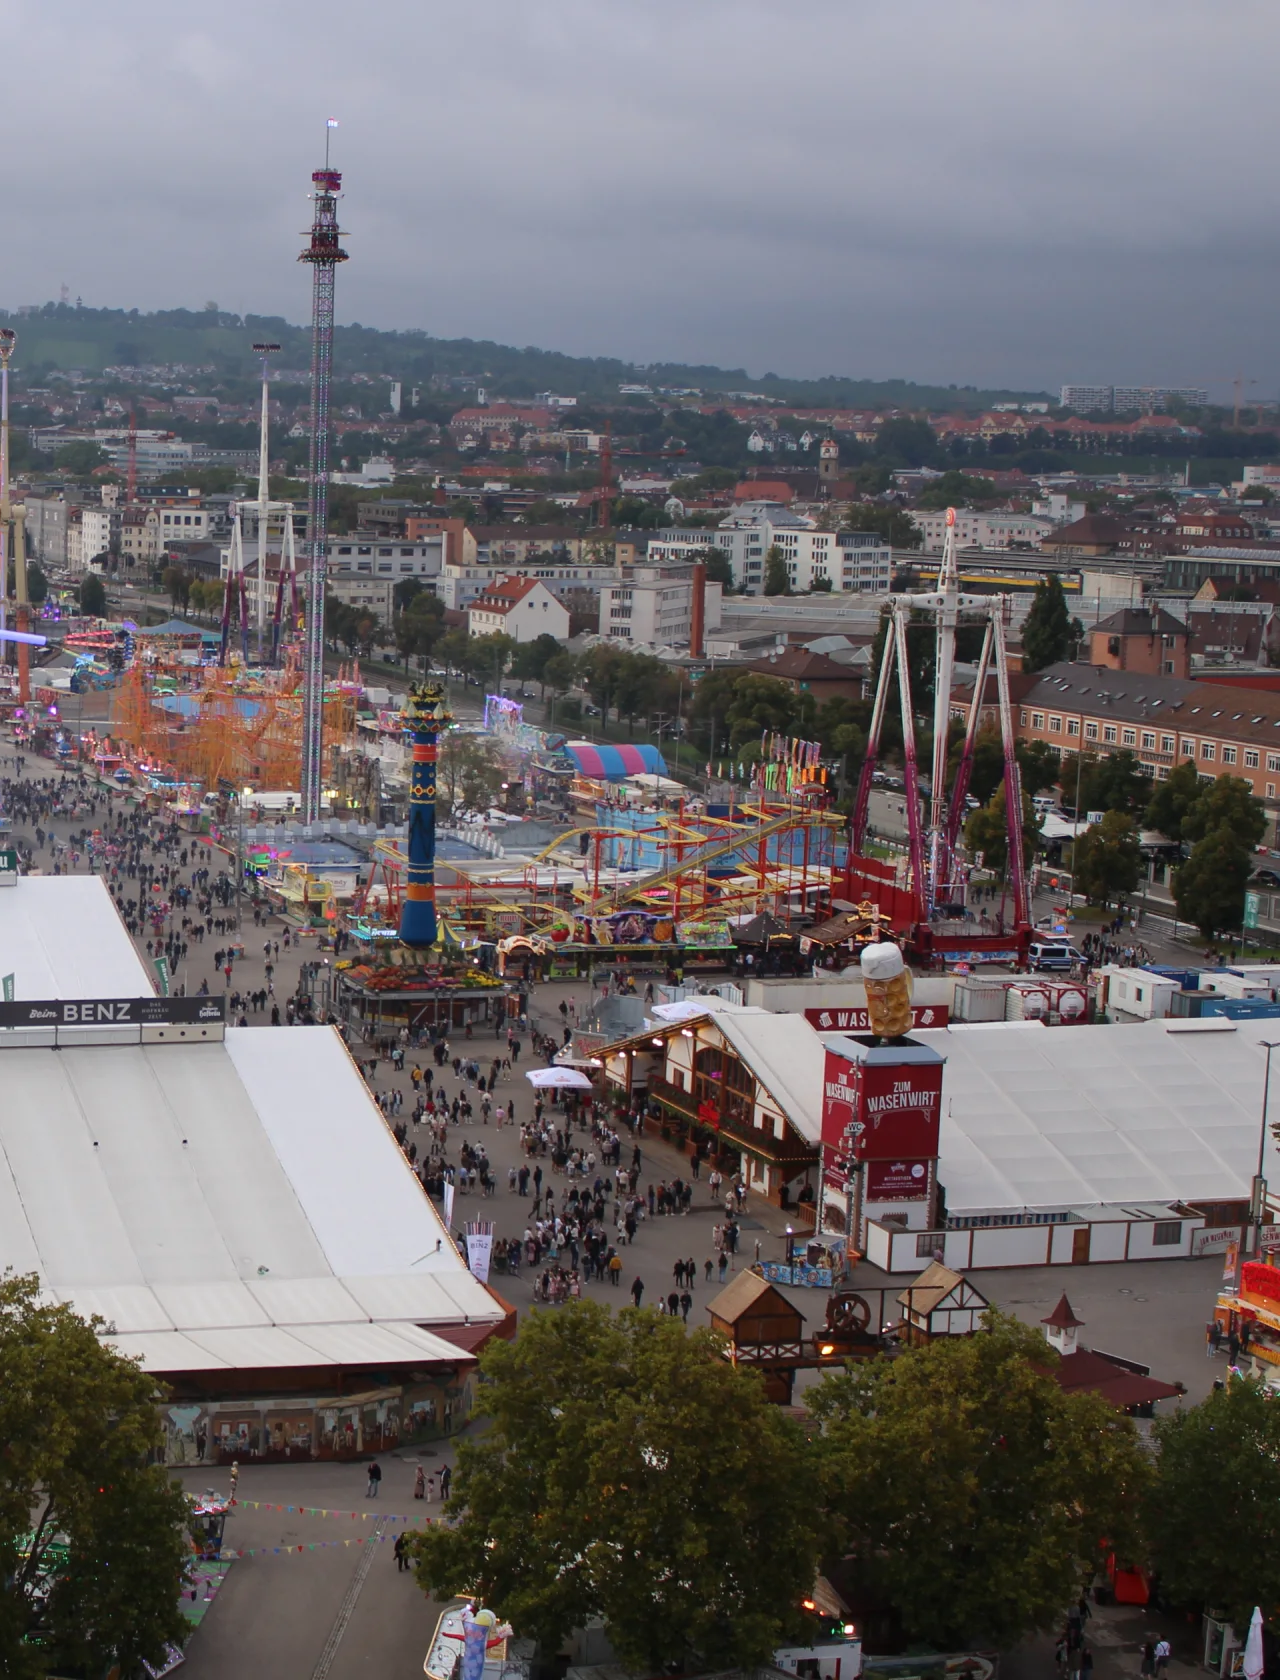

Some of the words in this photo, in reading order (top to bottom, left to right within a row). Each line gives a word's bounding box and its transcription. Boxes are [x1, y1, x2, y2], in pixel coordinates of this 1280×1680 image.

[29, 1009, 58, 1019] Beim
[63, 1003, 131, 1021] BENZ
[893, 1081, 911, 1093] ZUM
[867, 1091, 937, 1113] WASENWIRT
[848, 1123, 862, 1131] WC
